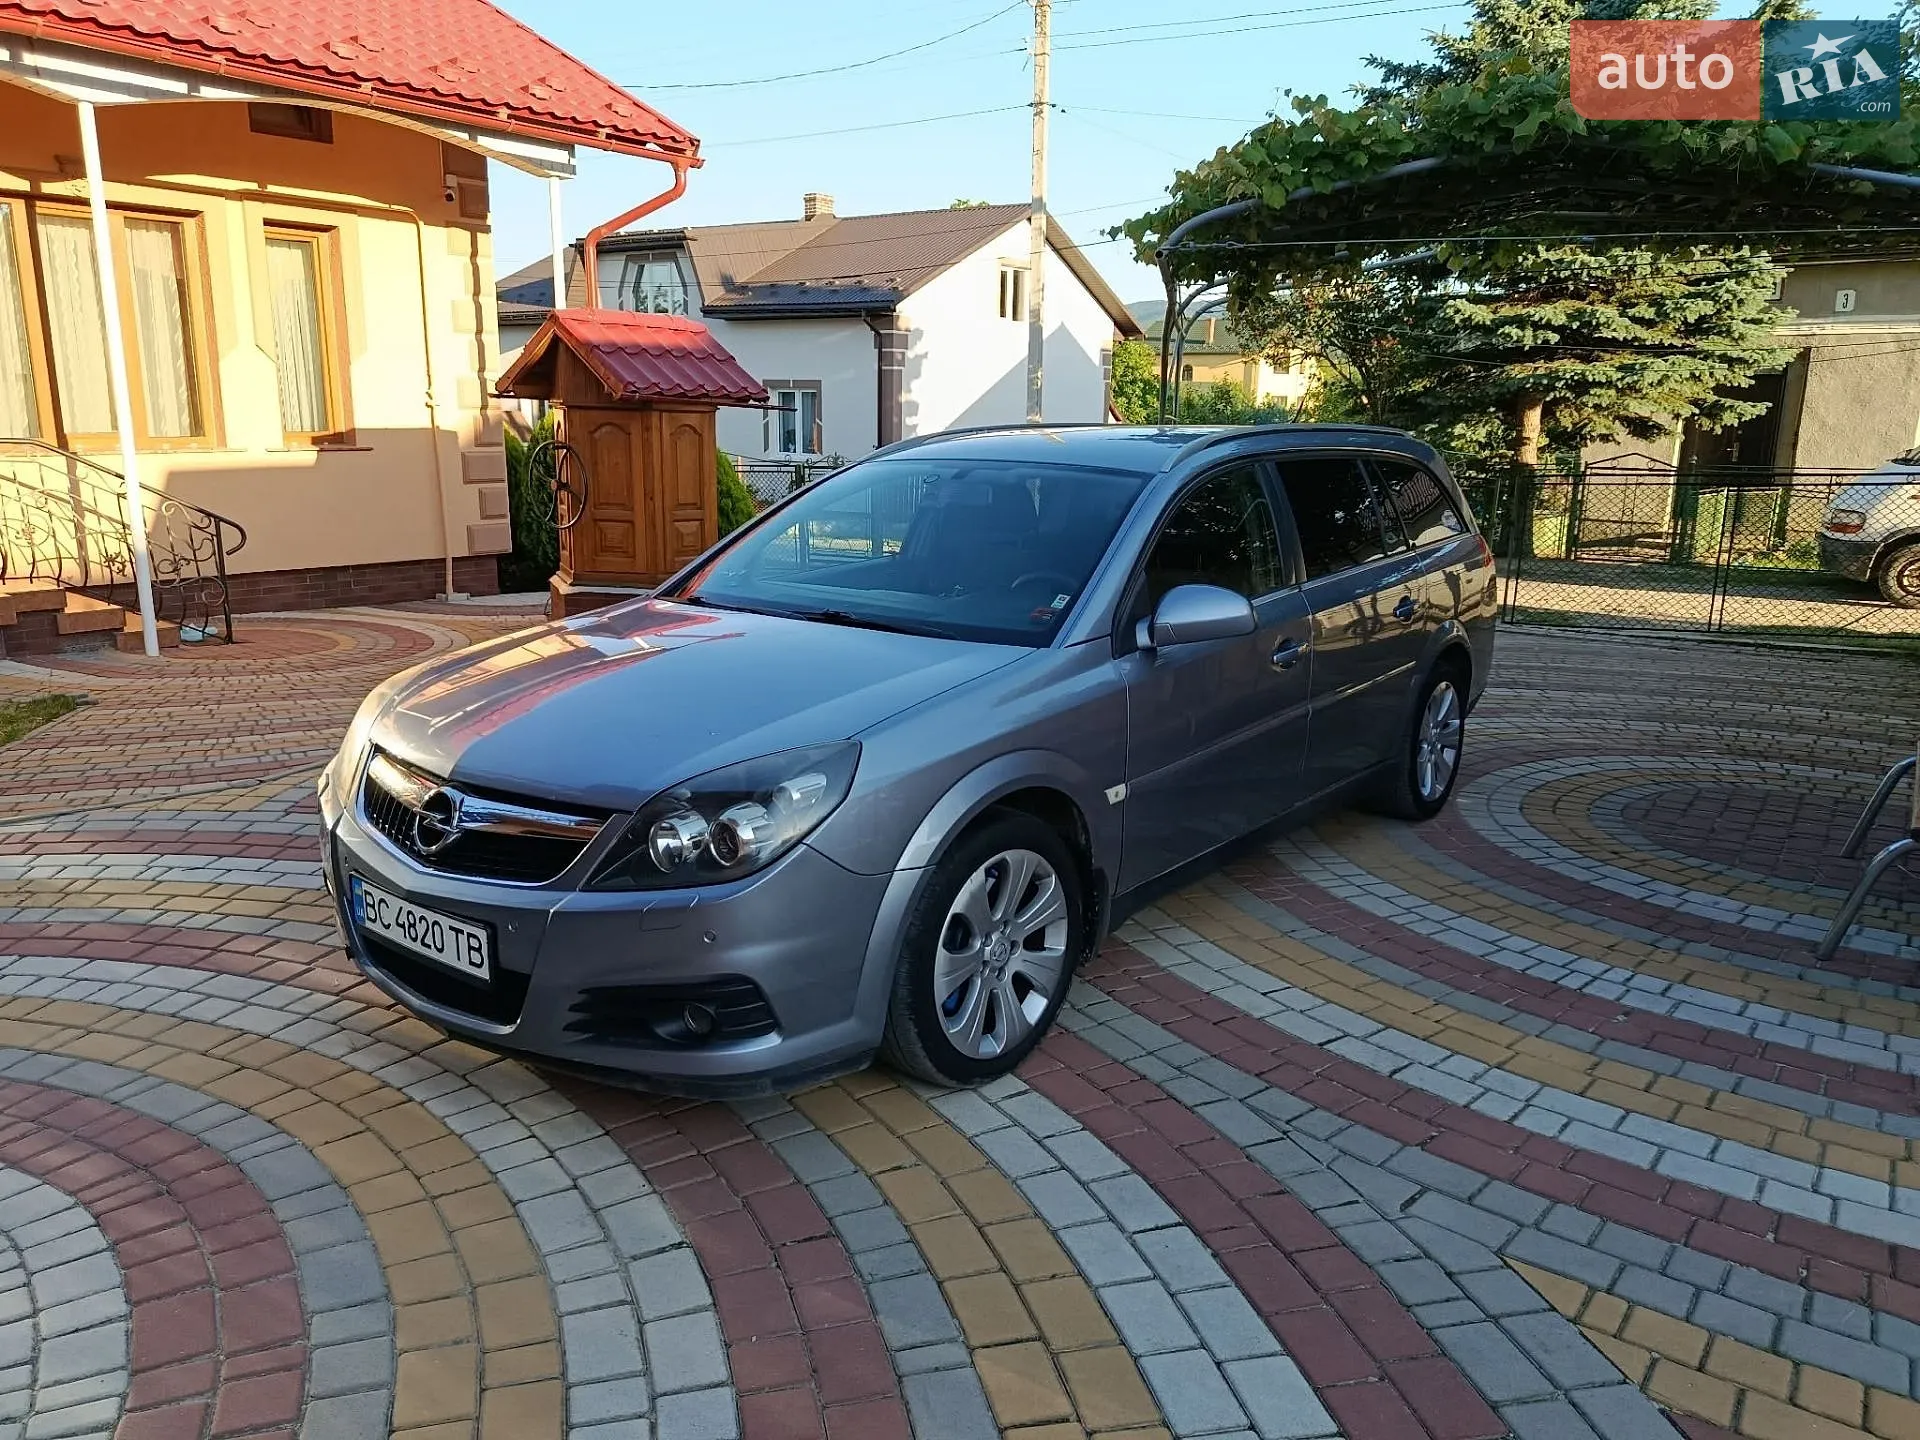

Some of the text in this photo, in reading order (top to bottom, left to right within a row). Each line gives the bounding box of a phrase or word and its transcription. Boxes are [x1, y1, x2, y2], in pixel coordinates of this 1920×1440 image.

[1842, 293, 1849, 309] 3
[364, 889, 485, 969] BC 4820 TB
